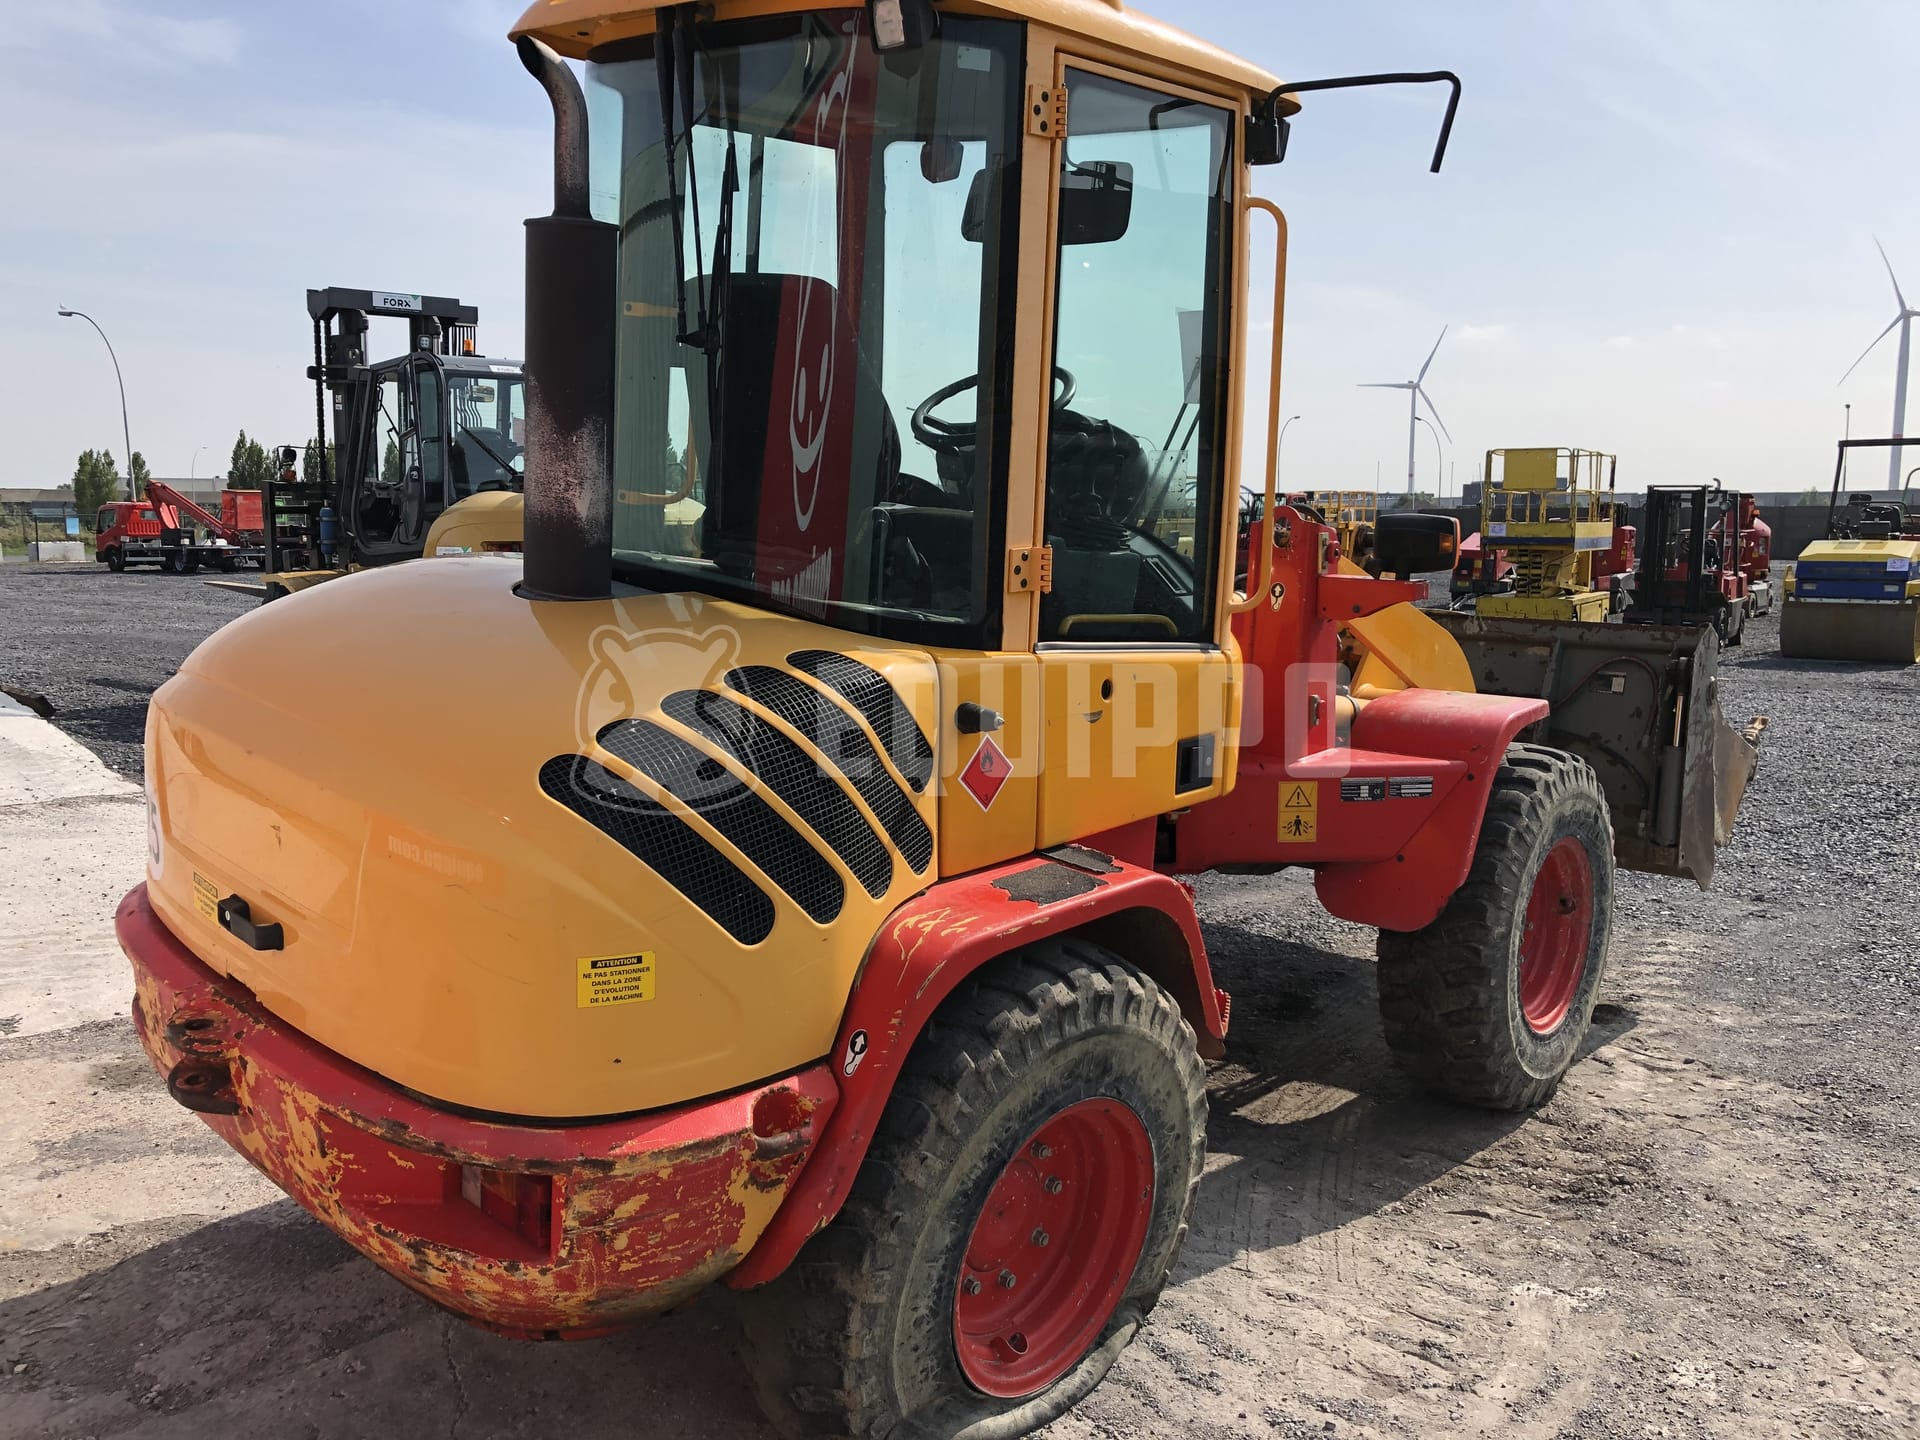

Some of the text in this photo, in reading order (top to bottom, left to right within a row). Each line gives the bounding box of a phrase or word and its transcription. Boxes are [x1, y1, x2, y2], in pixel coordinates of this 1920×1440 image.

[596, 957, 638, 968] ATTENTION
[610, 966, 650, 977] STATIONNER
[592, 979, 611, 987] DANS
[624, 976, 642, 984] ZONE
[594, 984, 640, 995] D'EVOLUTION
[612, 992, 643, 1001] MACHINE
